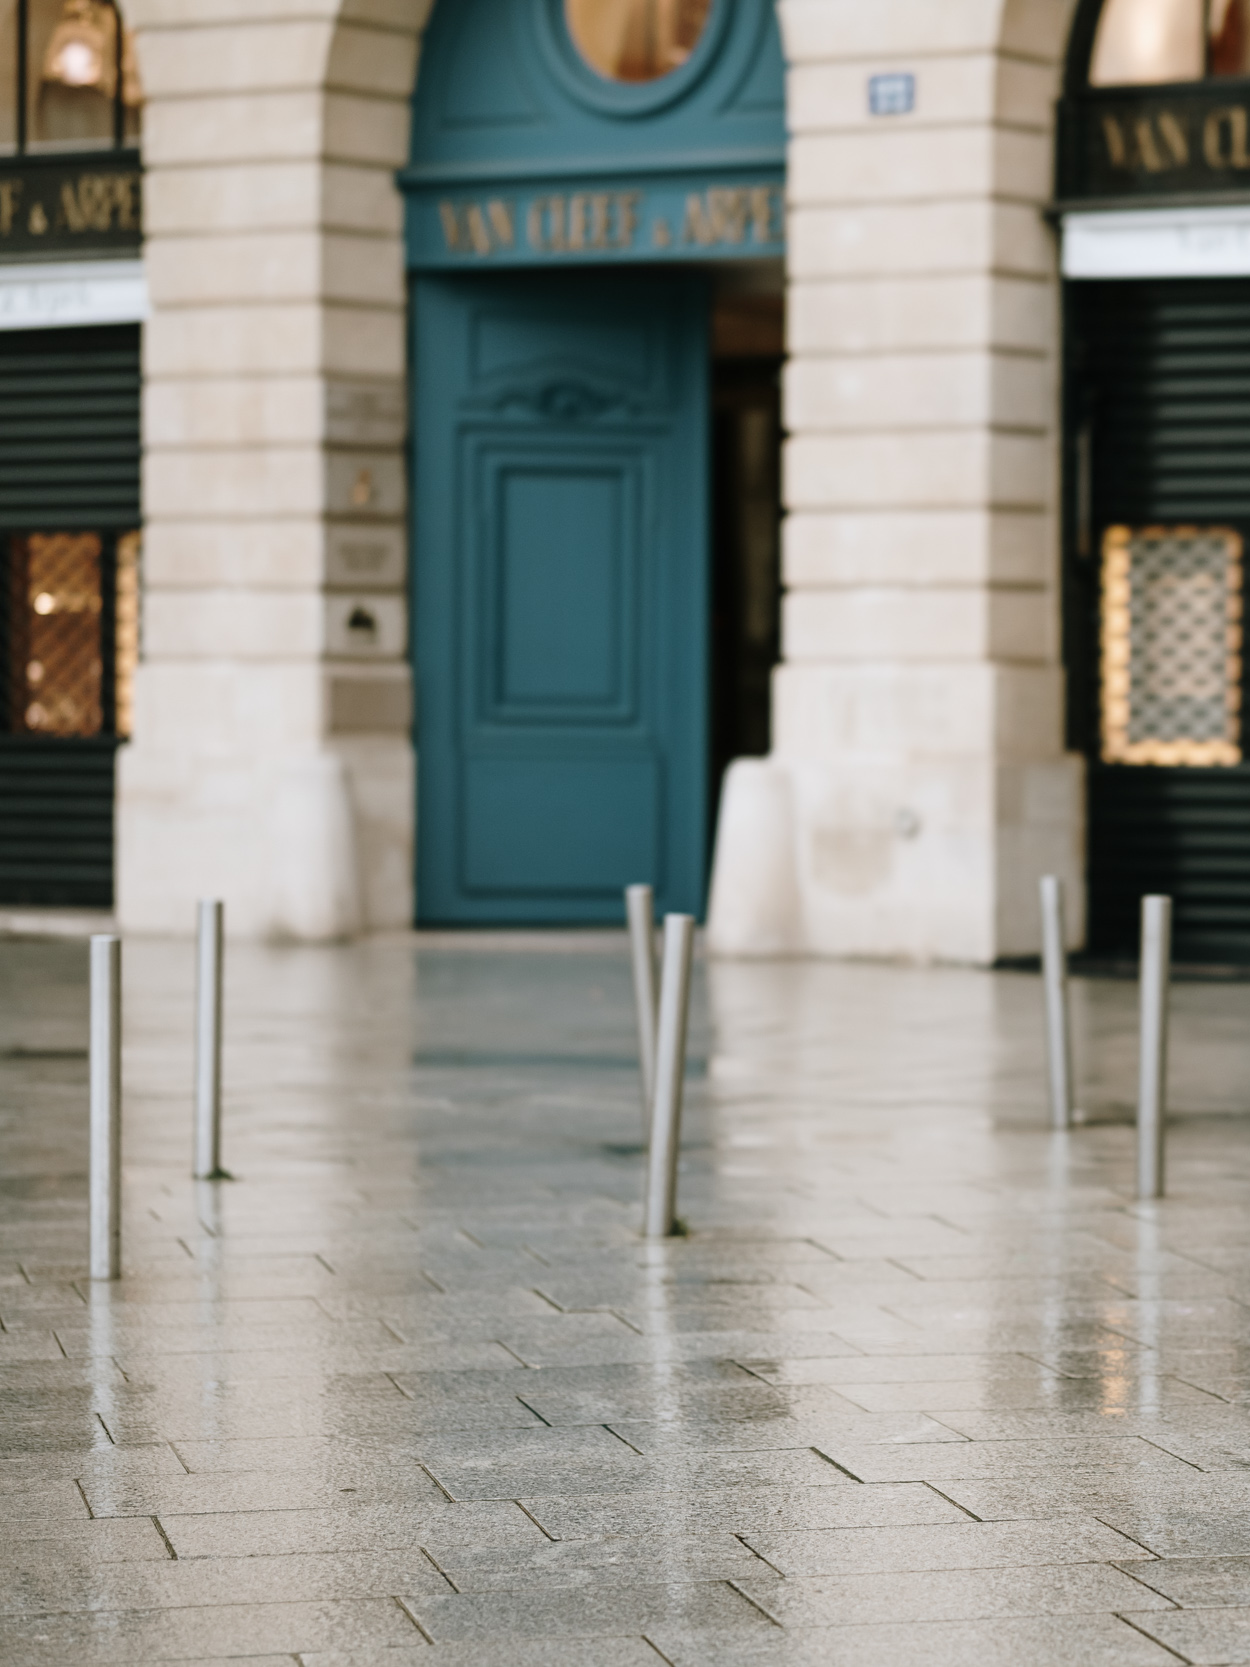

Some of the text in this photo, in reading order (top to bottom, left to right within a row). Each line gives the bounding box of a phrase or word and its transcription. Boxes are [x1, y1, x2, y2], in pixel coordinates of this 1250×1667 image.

[1103, 110, 1190, 172] VAN
[439, 198, 515, 257] VAN
[527, 189, 643, 252] CLEEF
